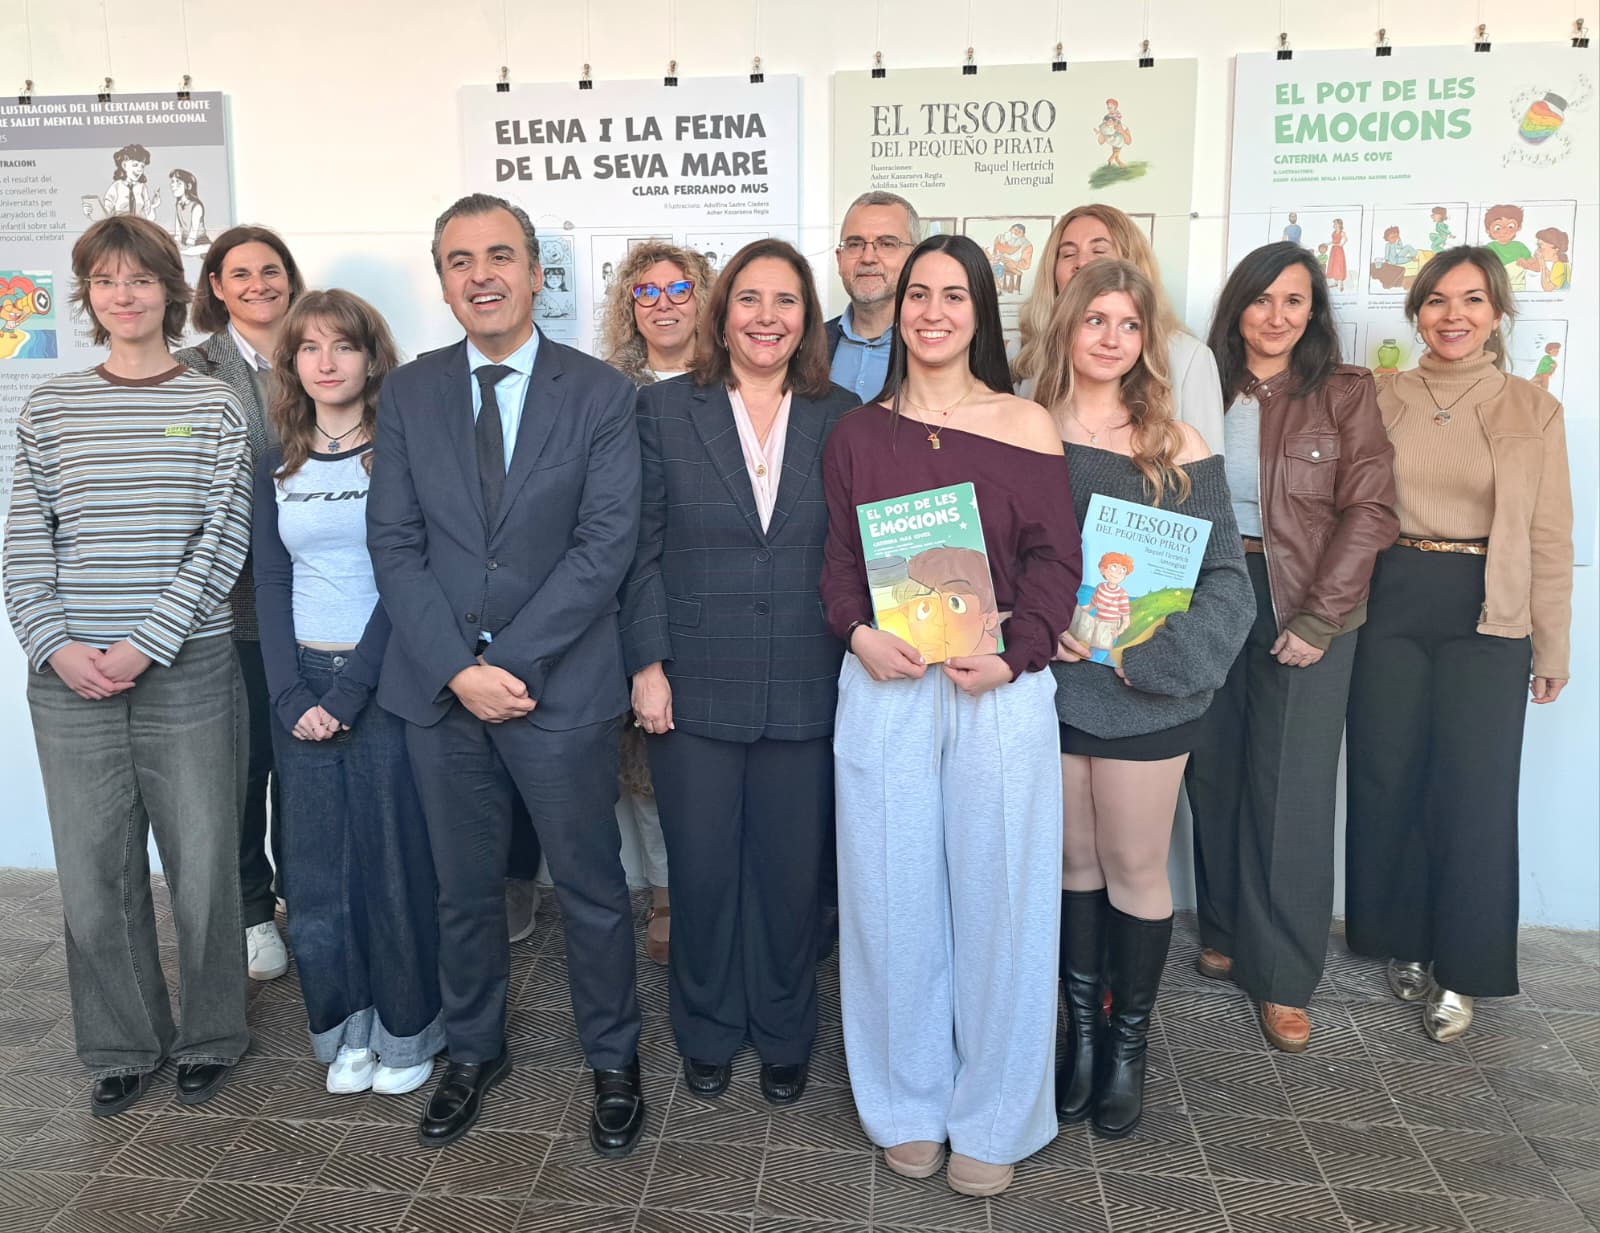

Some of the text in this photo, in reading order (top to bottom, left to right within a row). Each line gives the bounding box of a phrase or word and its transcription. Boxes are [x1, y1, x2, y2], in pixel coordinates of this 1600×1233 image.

[1275, 77, 1476, 105] EL POT DE LES
[10, 117, 40, 127] SALUT
[43, 116, 84, 126] MENTAL
[87, 115, 91, 125] I
[94, 114, 144, 125] BENESTAR
[146, 112, 207, 124] EMOCIONAL
[70, 103, 87, 113] DEL
[91, 102, 101, 113] III
[105, 101, 159, 112] CERTAMEN
[162, 100, 174, 111] DE
[177, 99, 210, 110] CONTE
[870, 99, 1056, 136] EL TESORO
[495, 113, 767, 145] ELENA I LA FEINA
[1274, 108, 1472, 144] EMOCIONS
[871, 135, 1054, 158] DEL PEQUEÑO PIRATA
[1274, 152, 1393, 164] CATERINA MAS COVE
[495, 150, 768, 182] DE LA SEVA MARE
[975, 159, 1054, 174] Raquel Hertrich
[1004, 172, 1053, 187] Amengual
[632, 183, 768, 196] CLARA FERRANDO MUS
[866, 492, 957, 521] EL POT DE LES
[869, 507, 960, 538] EMOCIONS
[1098, 505, 1198, 543] EL TESORO
[1096, 523, 1191, 555] DEL PEQUEÑO PIRATA
